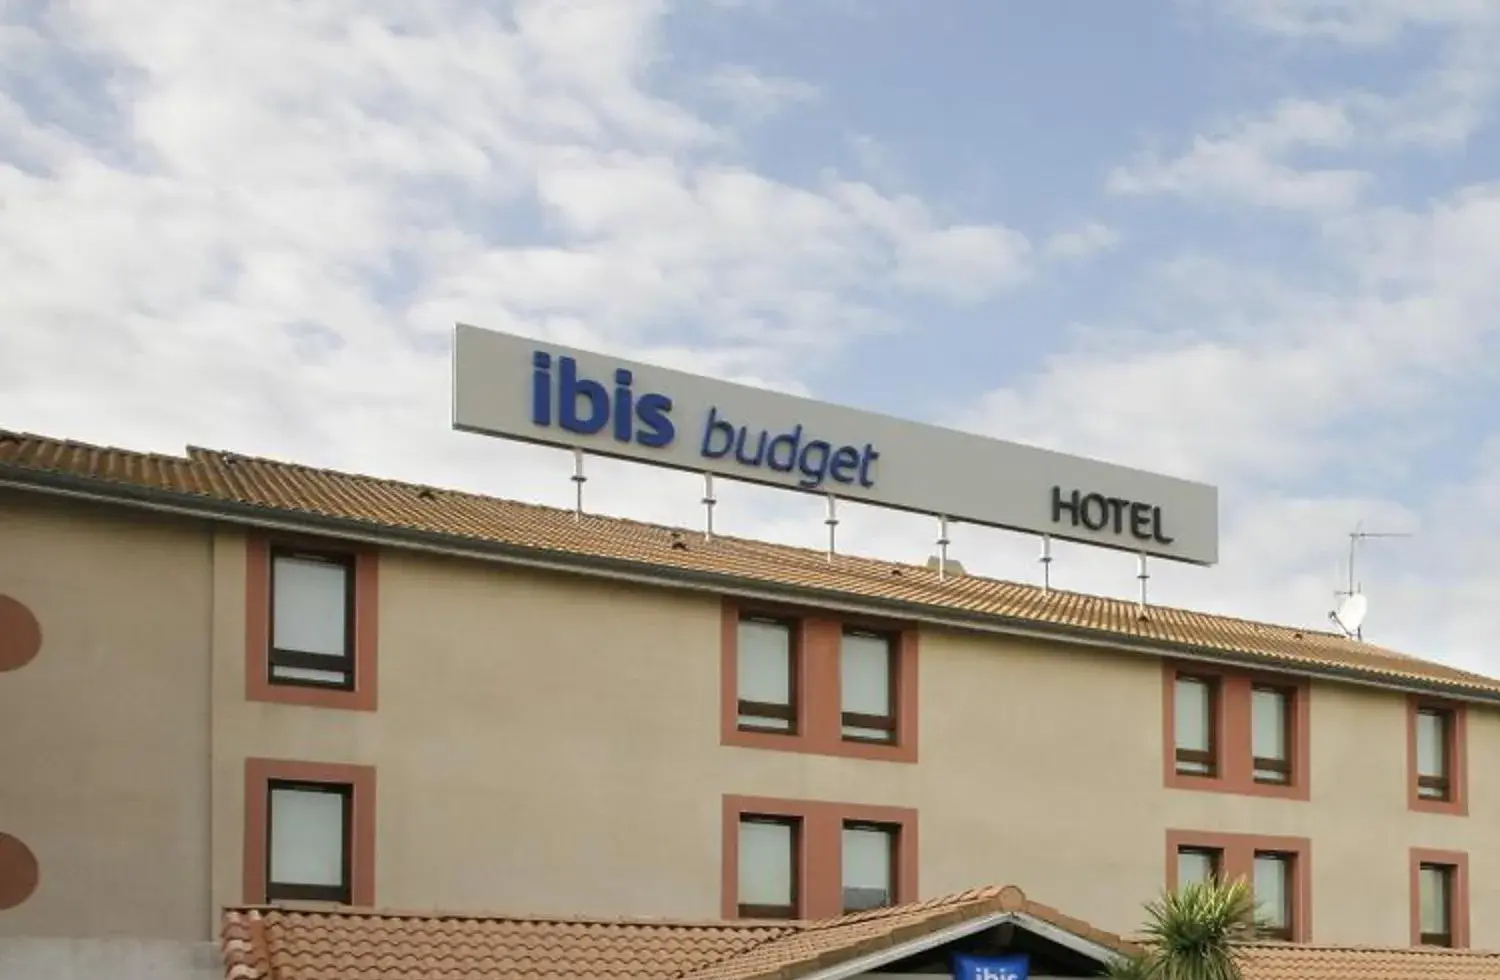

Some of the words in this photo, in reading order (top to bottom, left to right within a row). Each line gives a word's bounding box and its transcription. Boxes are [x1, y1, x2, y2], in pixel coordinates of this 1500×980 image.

[532, 350, 676, 448] ibis
[701, 405, 880, 488] budget
[1051, 485, 1175, 545] HOTEL
